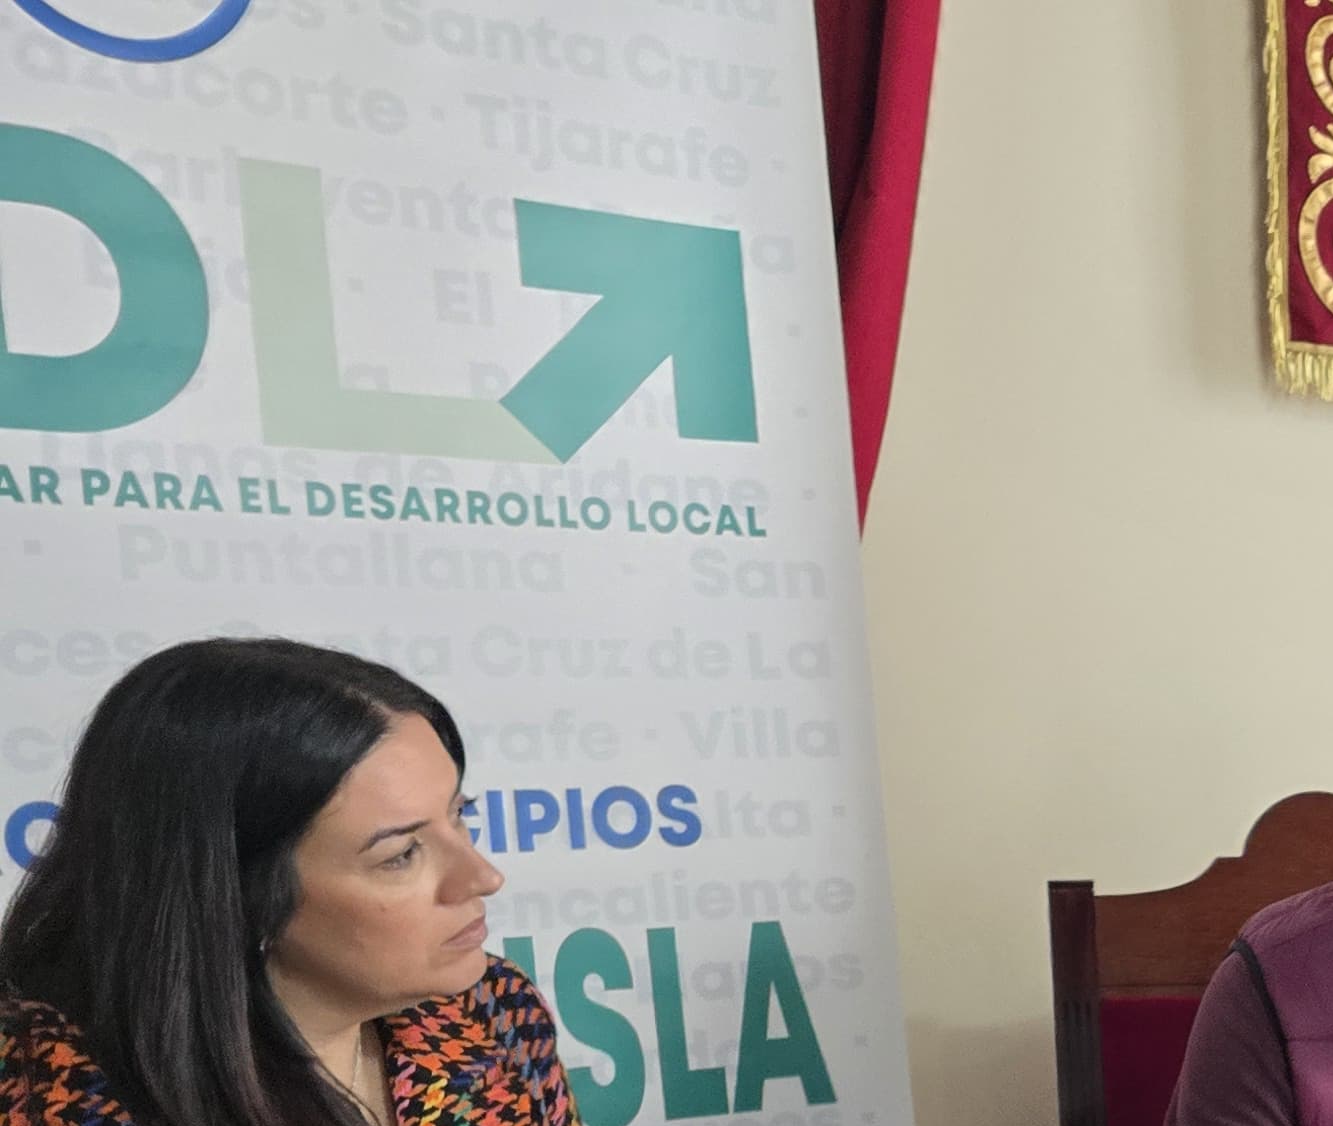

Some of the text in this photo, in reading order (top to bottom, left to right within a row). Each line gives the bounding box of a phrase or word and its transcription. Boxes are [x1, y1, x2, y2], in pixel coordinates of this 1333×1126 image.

[381, 0, 781, 108] Santa Cruz
[0, 13, 750, 188] azacorte Tijarafe
[433, 267, 494, 327] El
[79, 466, 225, 514] PARA
[237, 474, 292, 516] EL
[303, 479, 613, 532] DESARROLLO
[625, 498, 768, 538] LOCAL
[117, 522, 827, 600] Puntallana San
[470, 623, 633, 679] Cruz
[646, 627, 733, 680] de
[746, 632, 833, 682] La
[679, 706, 842, 760] Villa
